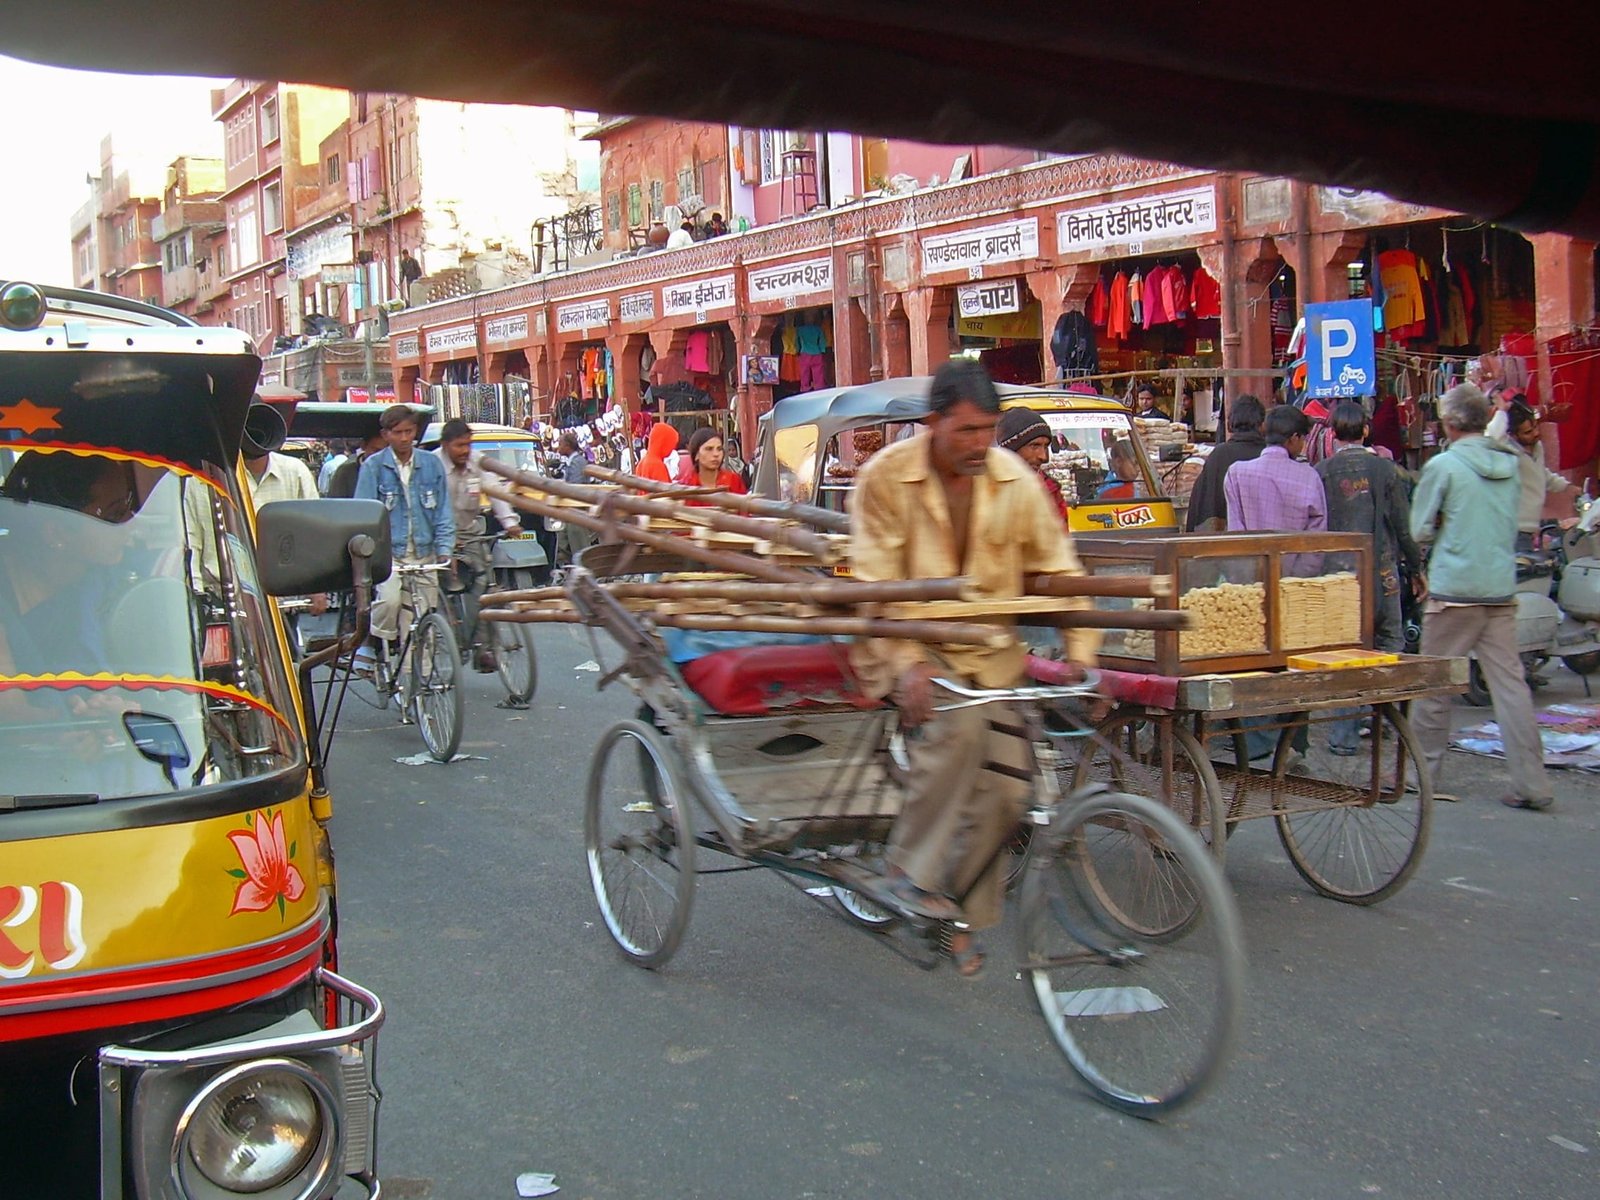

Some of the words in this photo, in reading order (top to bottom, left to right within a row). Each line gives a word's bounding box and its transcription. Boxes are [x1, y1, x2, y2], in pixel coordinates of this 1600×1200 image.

[1067, 212, 1104, 243] विनोद
[1154, 199, 1194, 228] सेन्टर
[927, 240, 982, 264] खण्डेलवाल
[985, 226, 1022, 259] ब्रादर्स
[754, 269, 803, 290] सत्यम
[804, 264, 830, 287] शूज़
[980, 284, 1015, 310] चाय
[1321, 318, 1357, 380] P
[1333, 385, 1340, 396] 2
